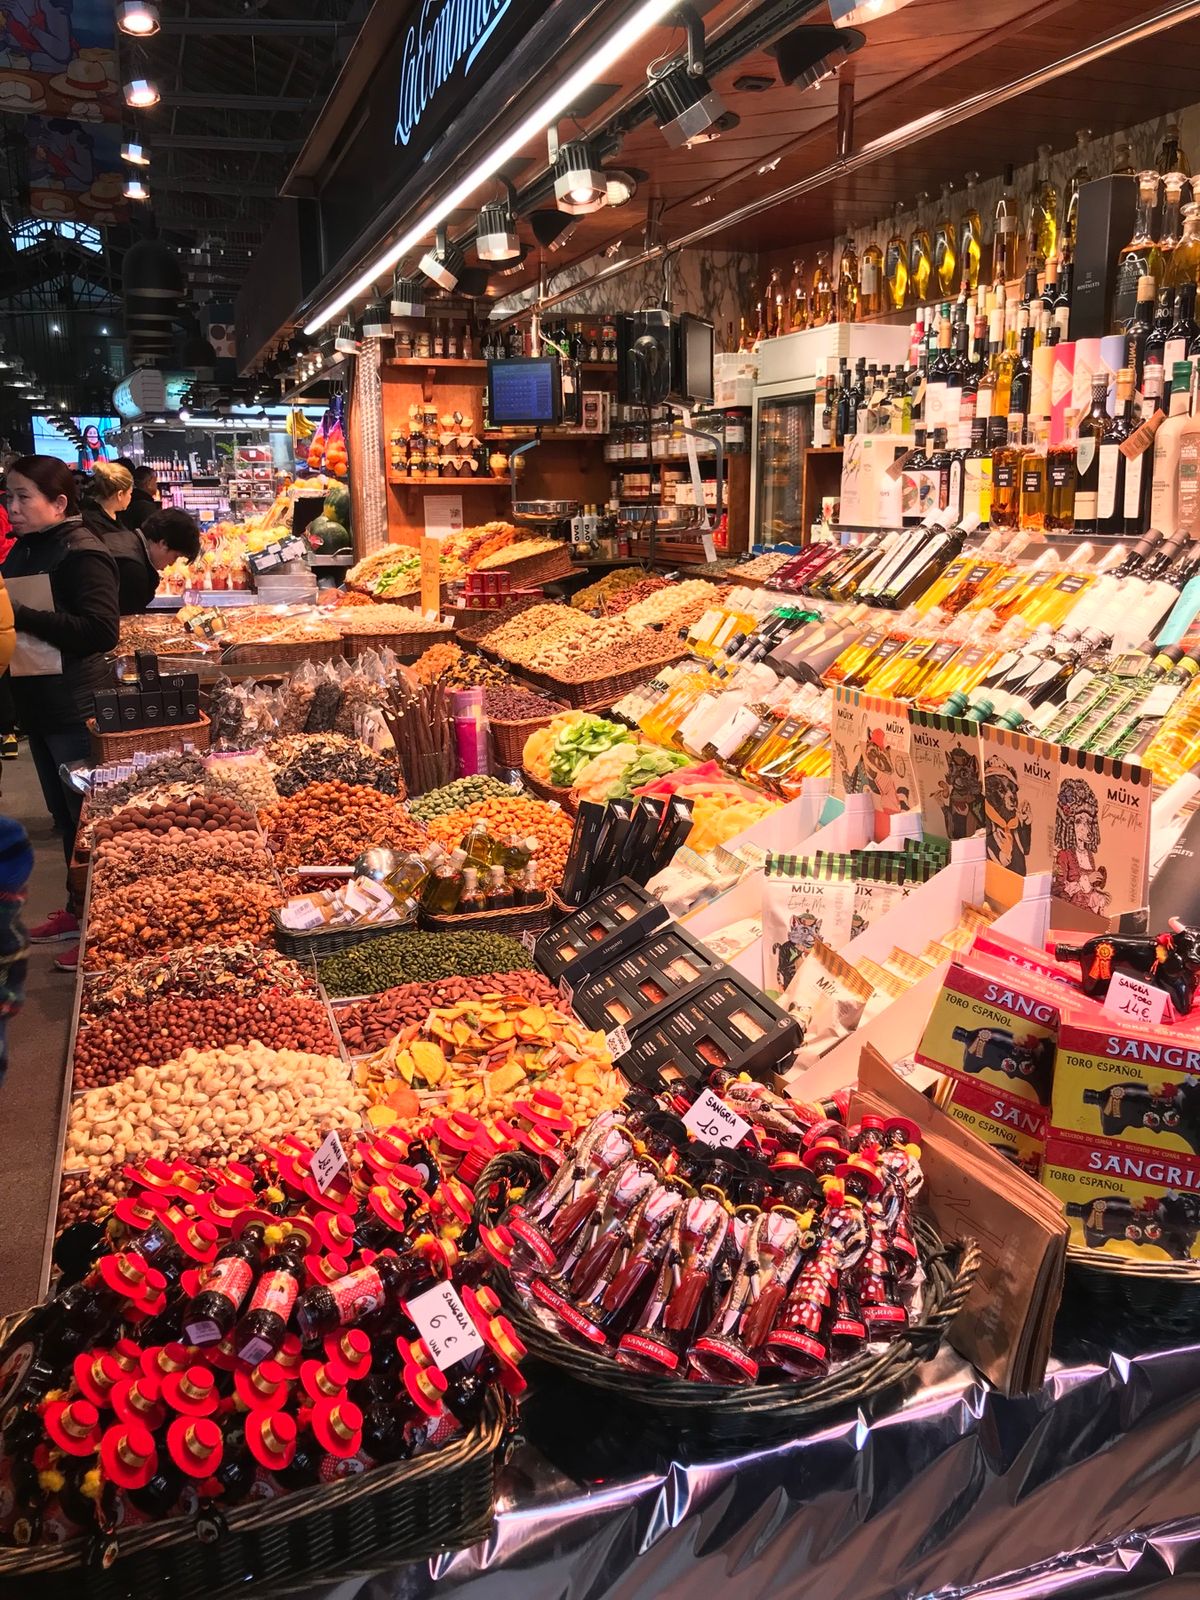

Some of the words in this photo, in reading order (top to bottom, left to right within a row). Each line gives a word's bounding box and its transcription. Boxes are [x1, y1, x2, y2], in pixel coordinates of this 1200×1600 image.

[886, 721, 905, 735] MÜIX
[913, 732, 941, 749] MÜIX
[1023, 759, 1052, 781] MÜIX
[1107, 787, 1141, 808] MÜIX
[791, 882, 825, 895] MÜIX
[945, 993, 970, 1009] TORO
[971, 1004, 1013, 1028] ESPAÑOL
[1132, 993, 1152, 1006] TORO
[1066, 1055, 1093, 1069] TORO
[1096, 1061, 1143, 1079] ESPAÑOL
[705, 1096, 737, 1127] SANGRIA
[696, 1118, 719, 1136] 10
[719, 1134, 733, 1147] €
[952, 1108, 976, 1124] TORO
[978, 1119, 1018, 1144] ESPAÑOL
[1050, 1169, 1076, 1183] TORO
[1079, 1175, 1126, 1193] ESPAÑOL
[521, 1223, 550, 1257] SANGRIA
[442, 1291, 468, 1331] SANGRIA
[429, 1314, 448, 1329] 6
[444, 1336, 458, 1349] €
[769, 1331, 811, 1347] SANGRIA
[428, 1338, 442, 1358] UNA
[625, 1336, 665, 1358] SANGRIA
[708, 1339, 750, 1366] SANGRIA
